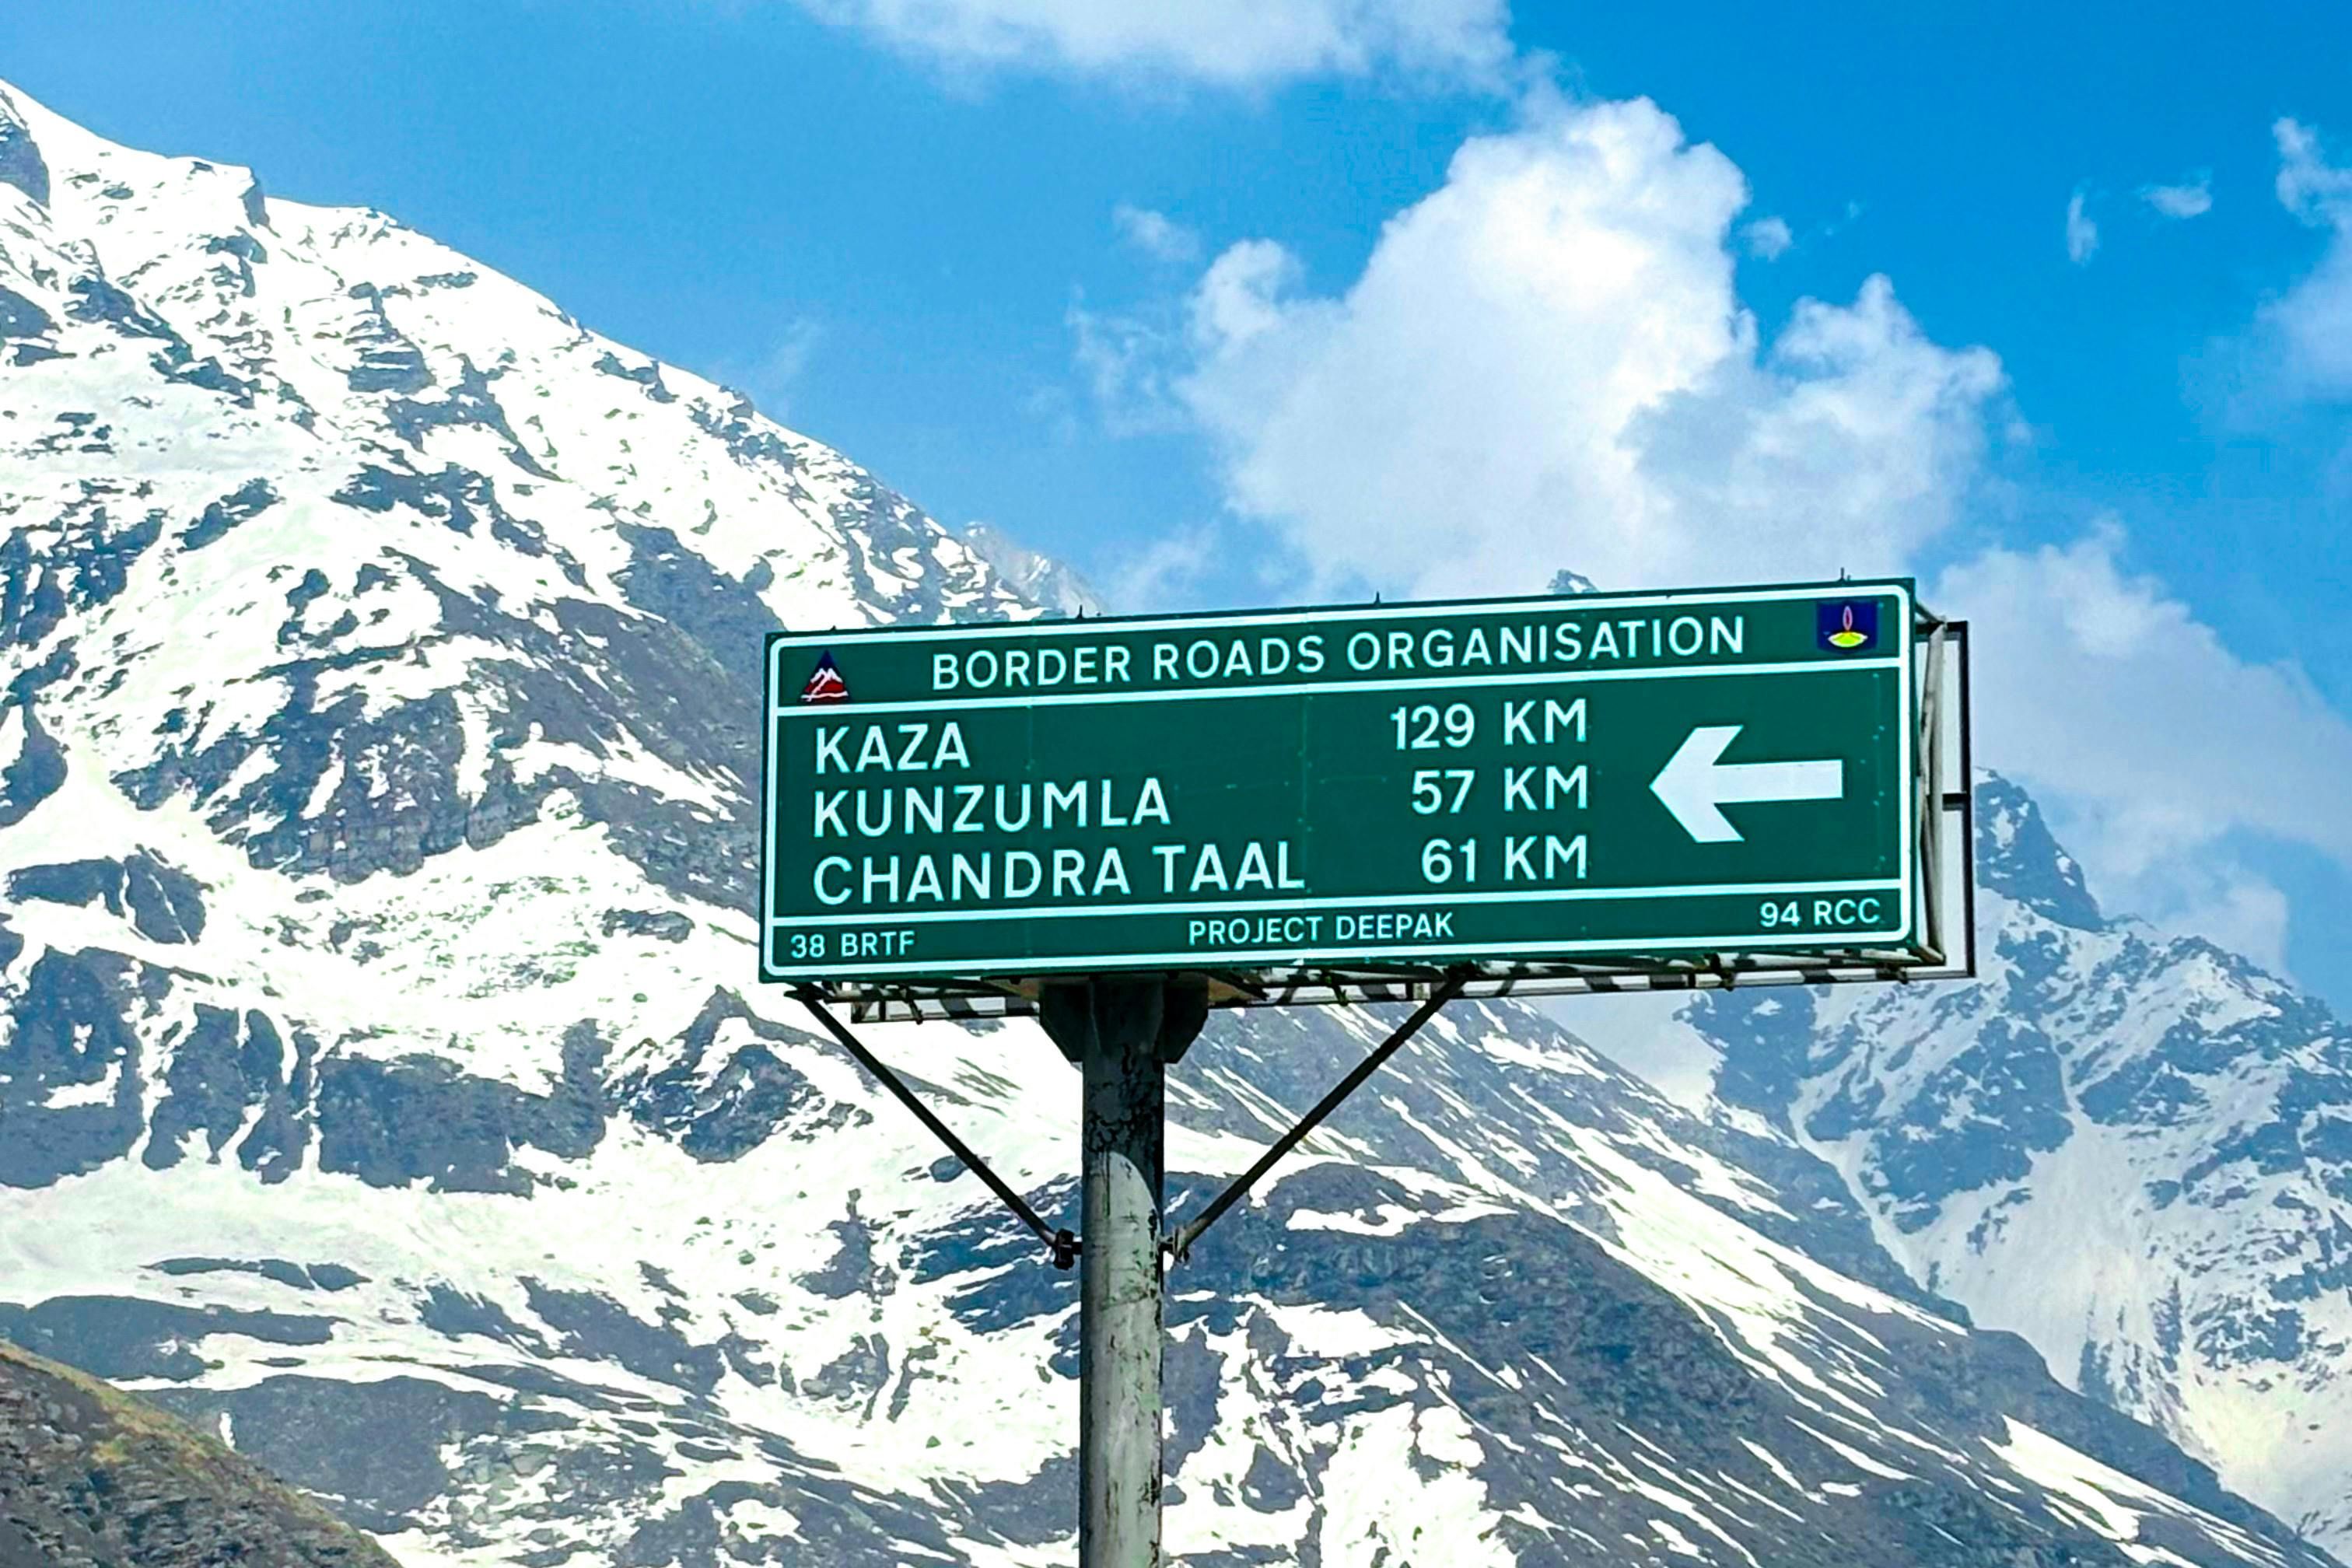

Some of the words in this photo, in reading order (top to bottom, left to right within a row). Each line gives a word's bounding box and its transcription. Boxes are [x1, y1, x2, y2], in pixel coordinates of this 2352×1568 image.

[933, 646, 1129, 690] BORDER
[1153, 635, 1325, 681] ROADS
[1348, 616, 1742, 670] ORGANISATION
[816, 722, 970, 773] KAZA
[1391, 703, 1475, 749] 129
[1503, 698, 1586, 744] KM
[814, 778, 1170, 836] KUNZUMLA
[1412, 770, 1474, 814] 57
[1504, 765, 1587, 810] KM
[814, 848, 1131, 905] CHANDRA
[1153, 842, 1304, 892] TAAL
[1422, 839, 1475, 883] 61
[1504, 835, 1587, 880] KM
[790, 934, 825, 958] 38
[841, 931, 914, 957] BRTF
[1189, 916, 1322, 943] PROJECT
[1336, 912, 1453, 940] DEEPAK
[1760, 901, 1801, 927] 94
[1814, 898, 1878, 925] RCC
